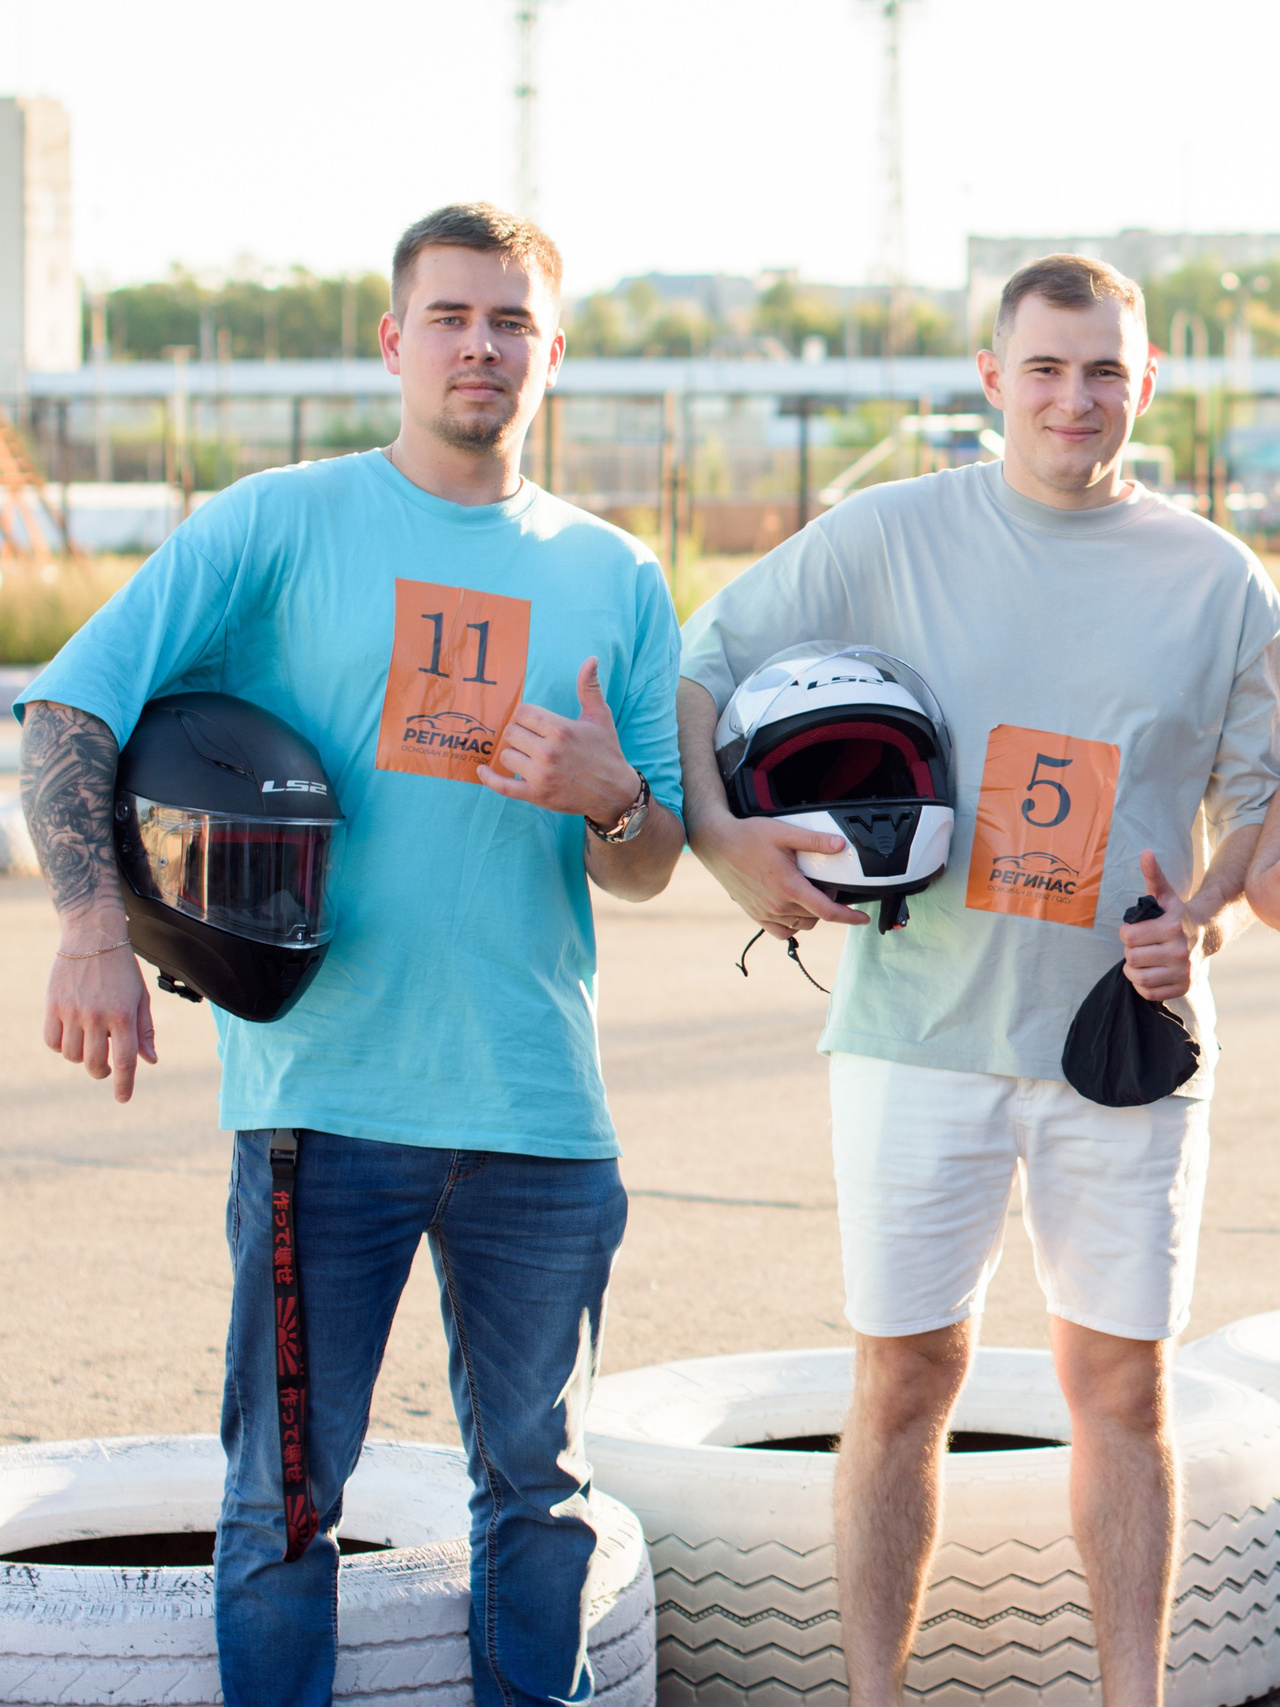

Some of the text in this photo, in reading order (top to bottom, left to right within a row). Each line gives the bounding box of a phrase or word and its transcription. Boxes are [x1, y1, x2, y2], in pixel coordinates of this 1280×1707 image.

[418, 611, 498, 686] 11
[807, 675, 884, 690] LS2
[402, 727, 494, 756] РЕГИНАС
[400, 744, 441, 757] ОСНОВАН
[451, 752, 468, 761] 1992
[468, 755, 491, 766] ГОДУ
[262, 779, 328, 796] LS2
[1021, 752, 1074, 829] 5
[989, 867, 1077, 895] РЕГИНАС
[987, 884, 1025, 895] ОСНОВАН
[1026, 890, 1033, 898] В
[1051, 895, 1073, 905] ГОДУ
